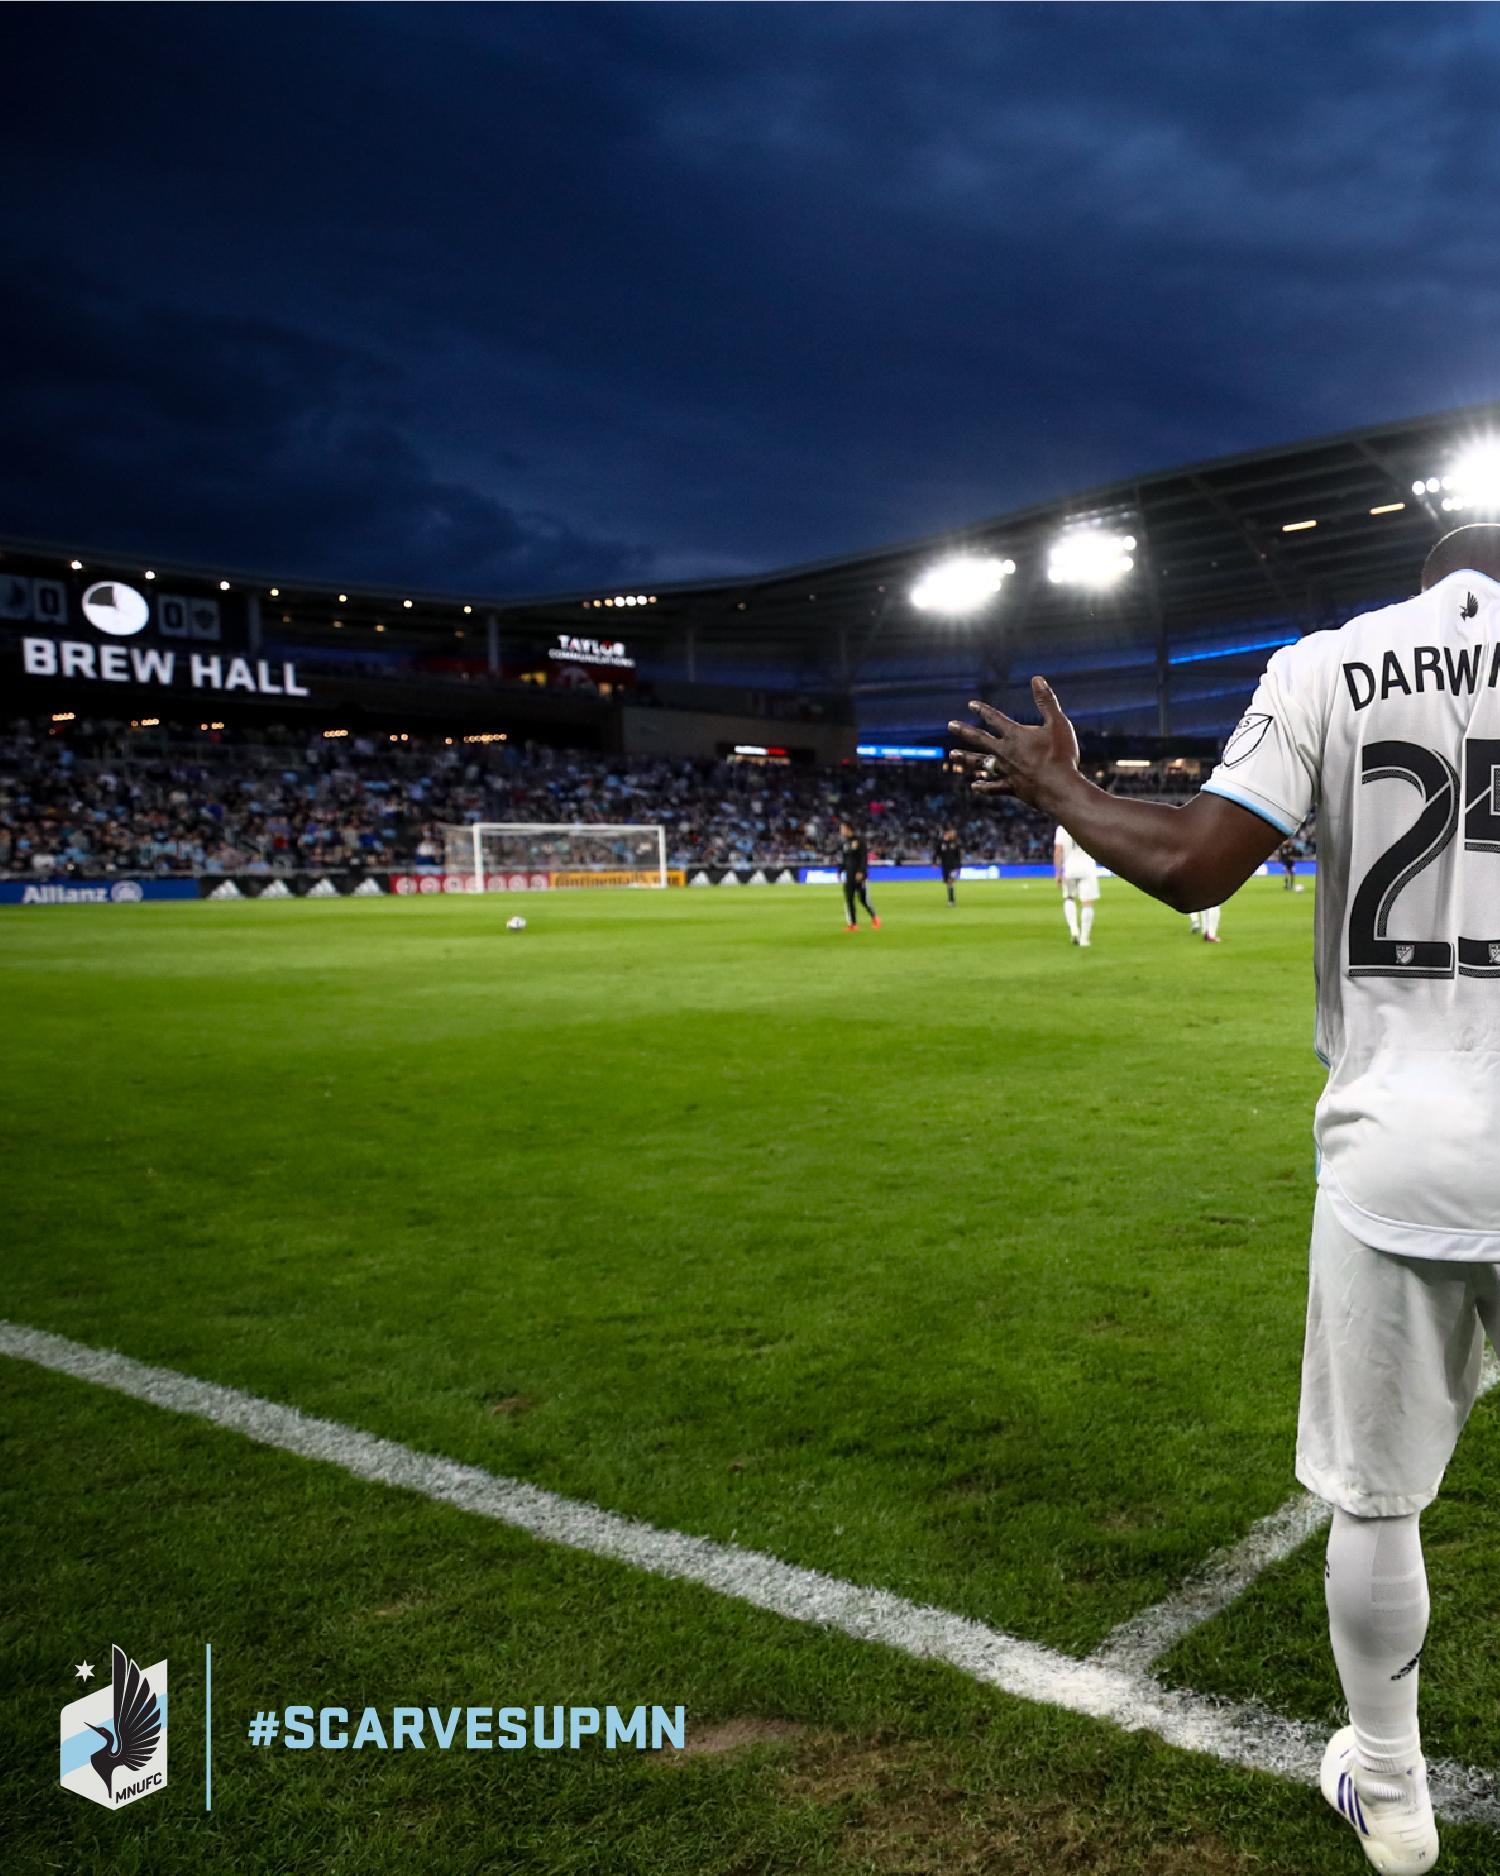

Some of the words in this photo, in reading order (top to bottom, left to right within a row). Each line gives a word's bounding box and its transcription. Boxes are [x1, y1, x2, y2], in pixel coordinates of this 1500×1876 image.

[23, 637, 174, 685] BREW
[190, 653, 310, 697] HALL
[23, 884, 107, 903] Allianz
